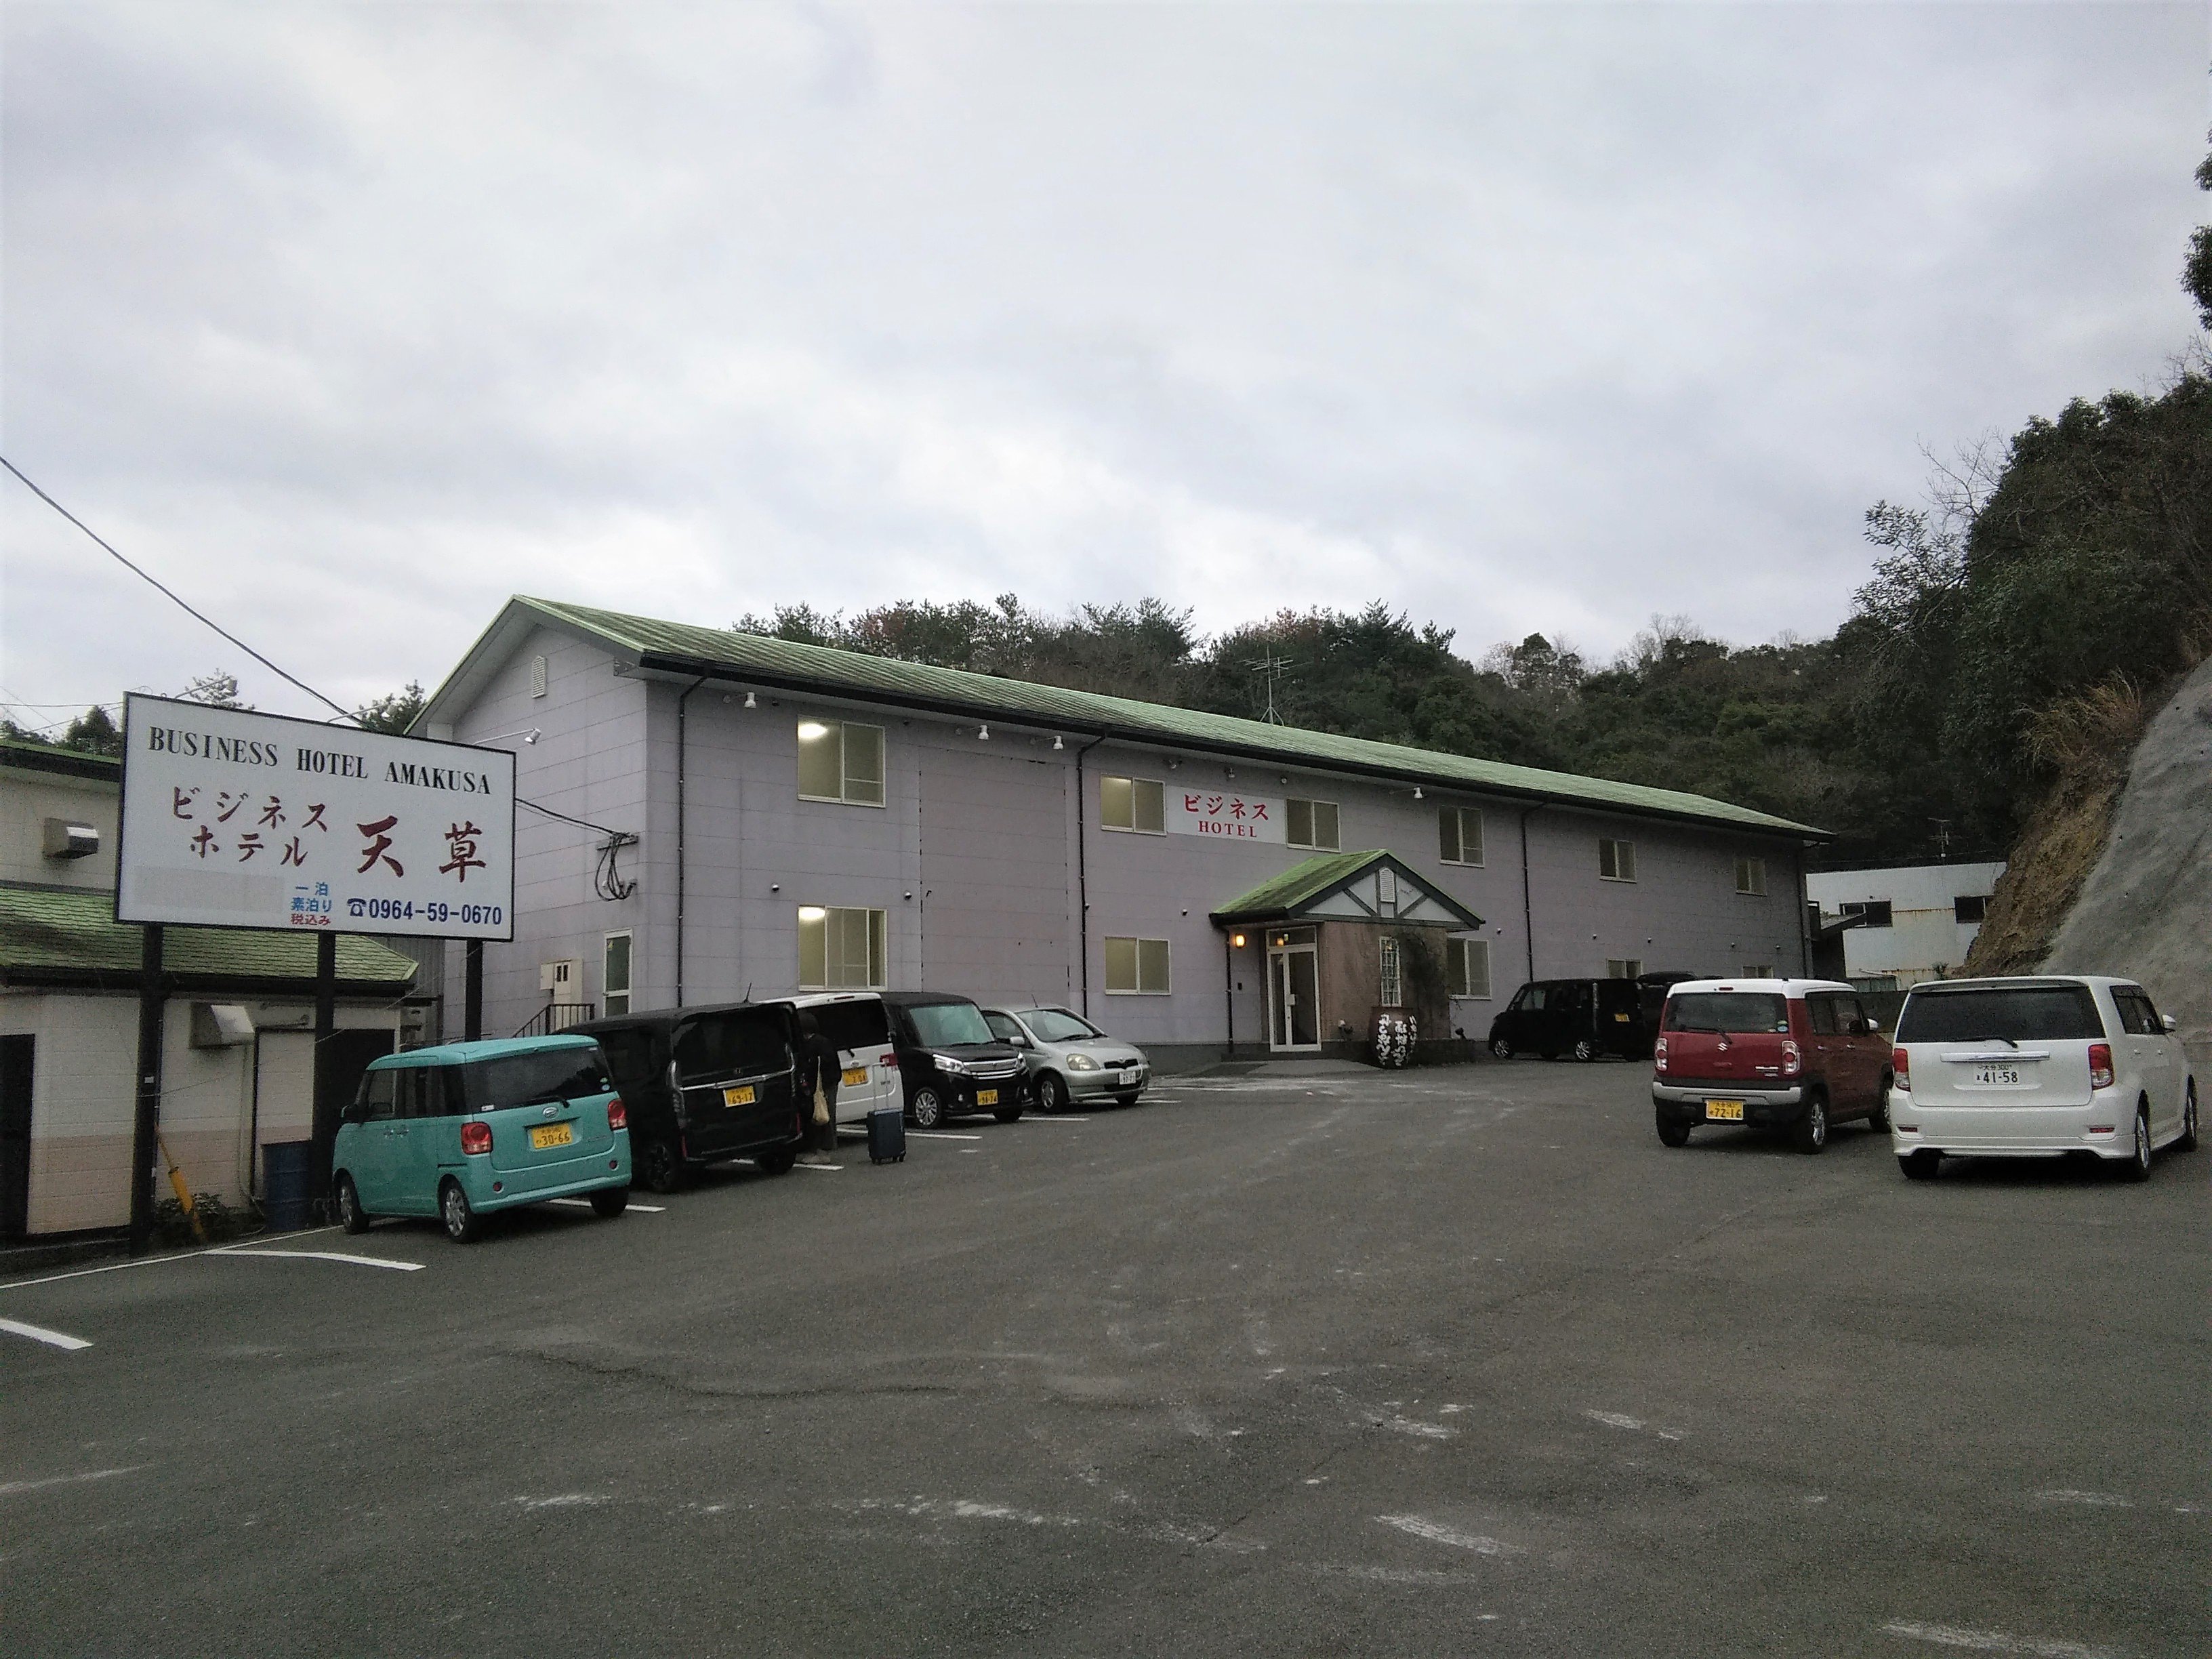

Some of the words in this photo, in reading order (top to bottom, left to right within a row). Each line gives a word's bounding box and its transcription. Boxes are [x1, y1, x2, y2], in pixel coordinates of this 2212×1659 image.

[148, 726, 279, 766] BUSINESS
[296, 747, 369, 779] HOTEL
[384, 760, 491, 795] AMAKUSA
[172, 785, 328, 832] ビジネス
[1184, 794, 1269, 821] ビジネス
[1198, 820, 1257, 838] HOTEL
[190, 824, 308, 867] ホテル
[356, 815, 487, 883] 天草
[295, 881, 329, 896] 一泊
[290, 896, 333, 913] 素泊り
[369, 898, 502, 925] 0964-59-0670
[290, 914, 331, 926] 税込み
[1983, 1071, 2018, 1084] 41-58
